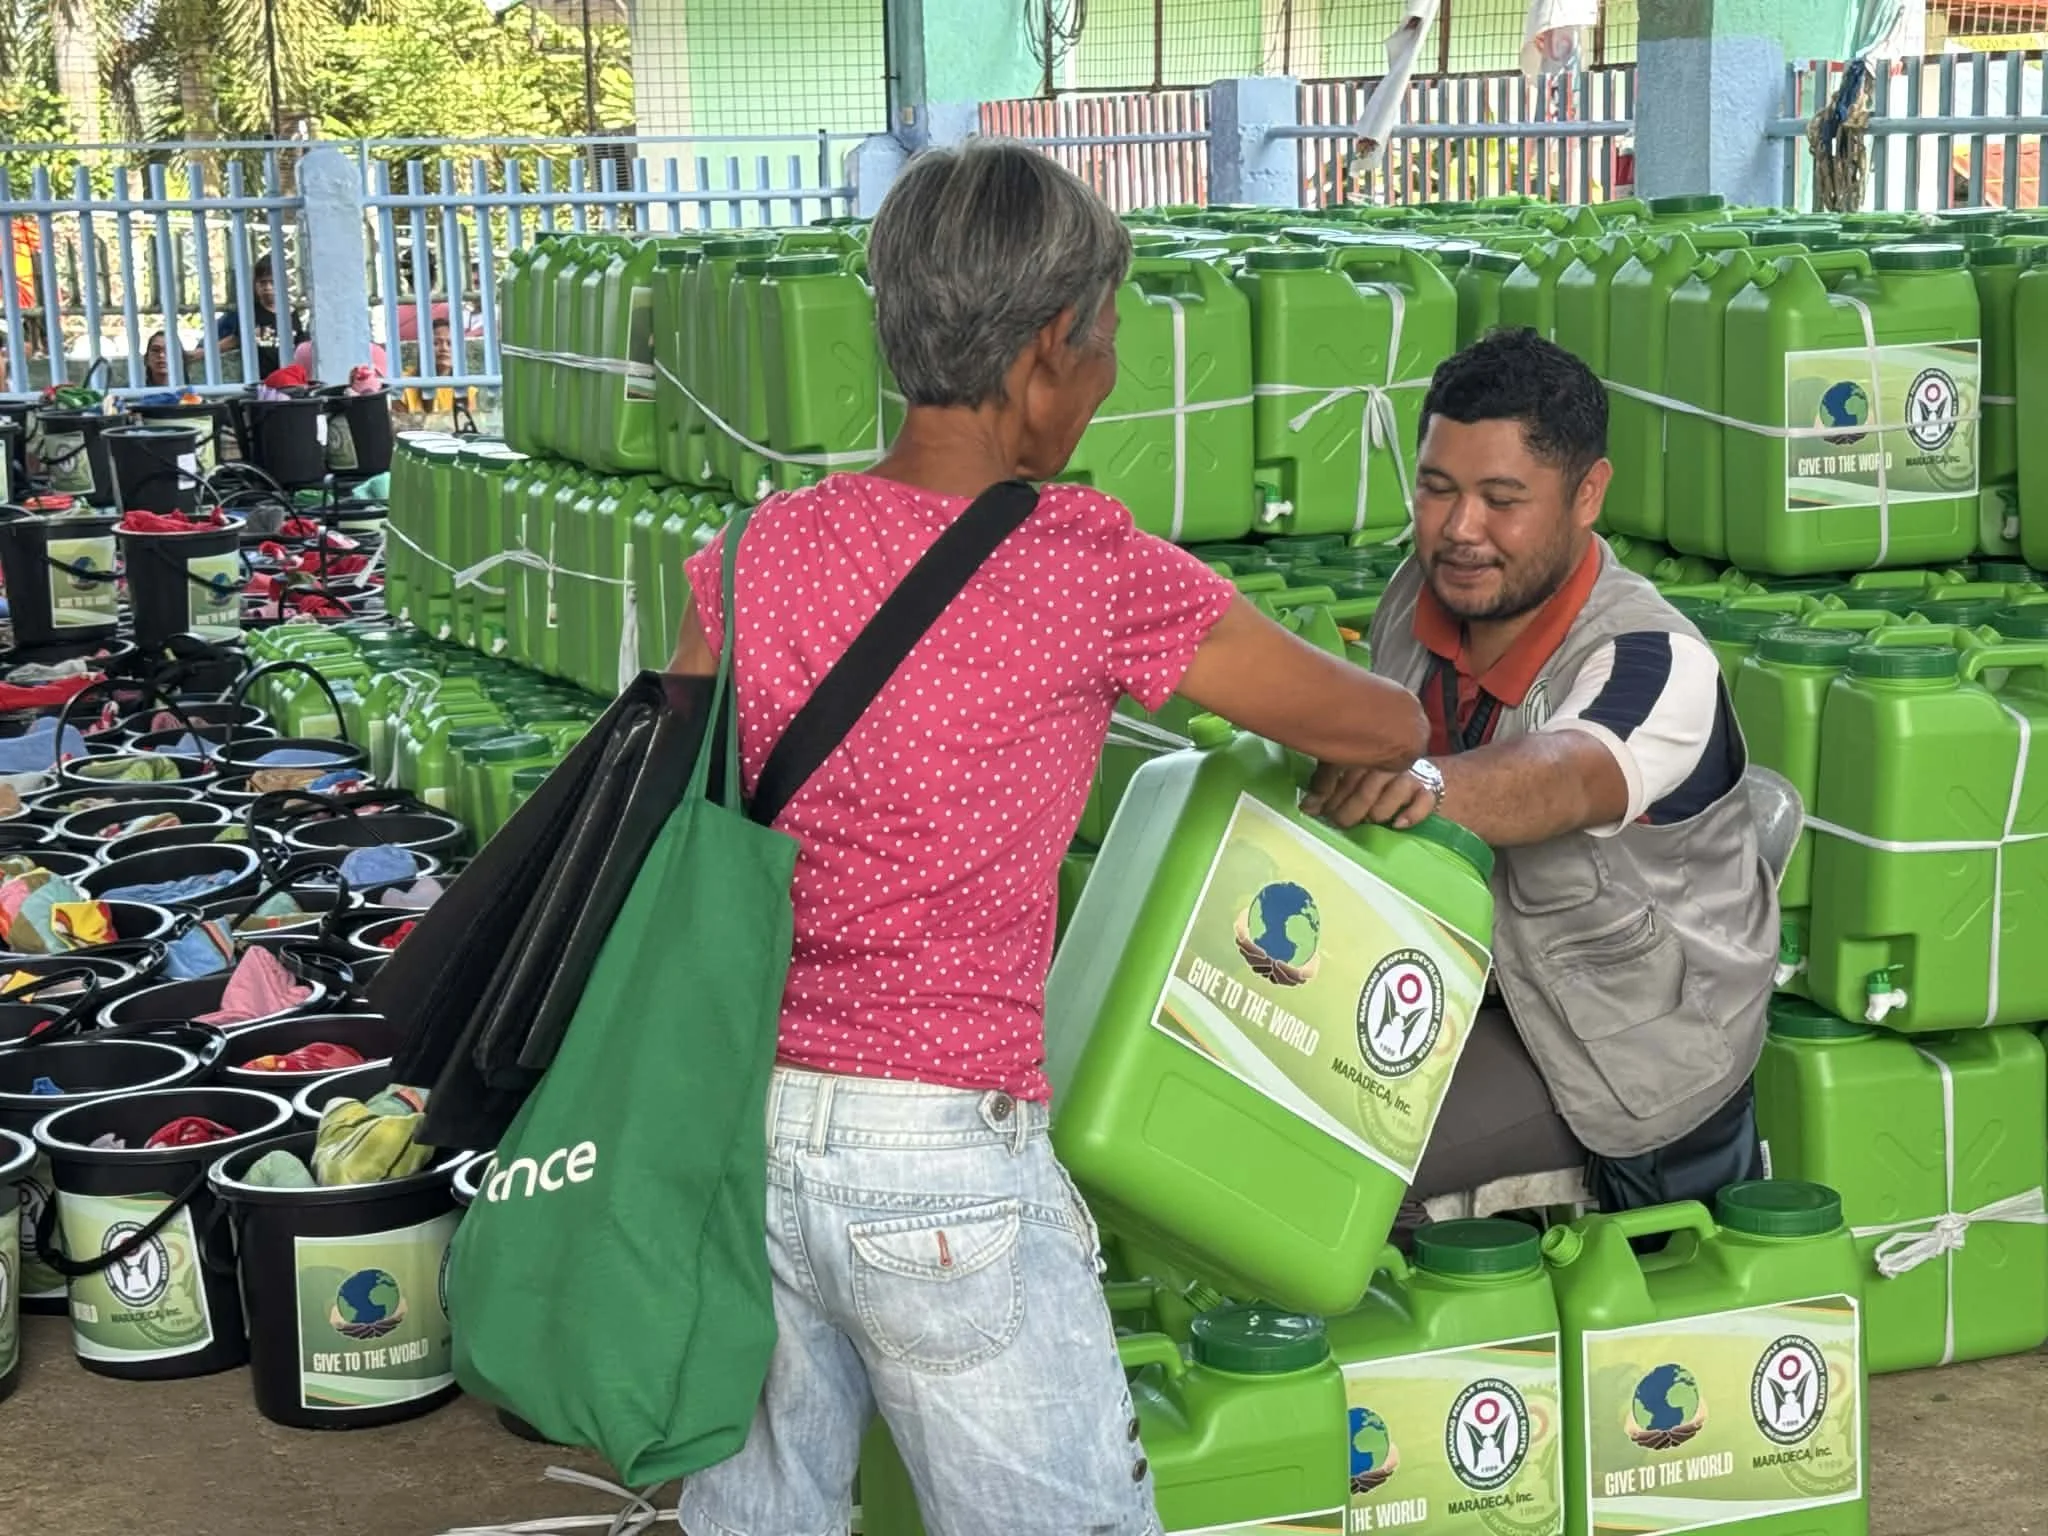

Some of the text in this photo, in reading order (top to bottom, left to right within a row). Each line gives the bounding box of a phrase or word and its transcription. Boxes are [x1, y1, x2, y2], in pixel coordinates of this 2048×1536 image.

[1798, 452, 1893, 476] GIVE TO THE WORD
[1378, 952, 1411, 972] PEOPLE
[1412, 952, 1442, 1020] DEVELOPMENT
[1187, 956, 1321, 1057] GIVE TO THE WORLD
[1331, 1057, 1411, 1117] MARADECA, Inc.
[480, 1140, 597, 1203] ance
[312, 1352, 342, 1373] GIVE
[343, 1351, 361, 1372] TO
[362, 1347, 387, 1370] THE
[388, 1338, 429, 1366] WORLD
[1605, 1451, 1734, 1496] GIVE TO THE WORLD
[1752, 1448, 1814, 1469] MARADECA,
[1815, 1446, 1833, 1457] Inc.
[1375, 1497, 1428, 1529] WORLD
[1448, 1493, 1514, 1515] MARADECA,
[1515, 1491, 1536, 1504] Inc.
